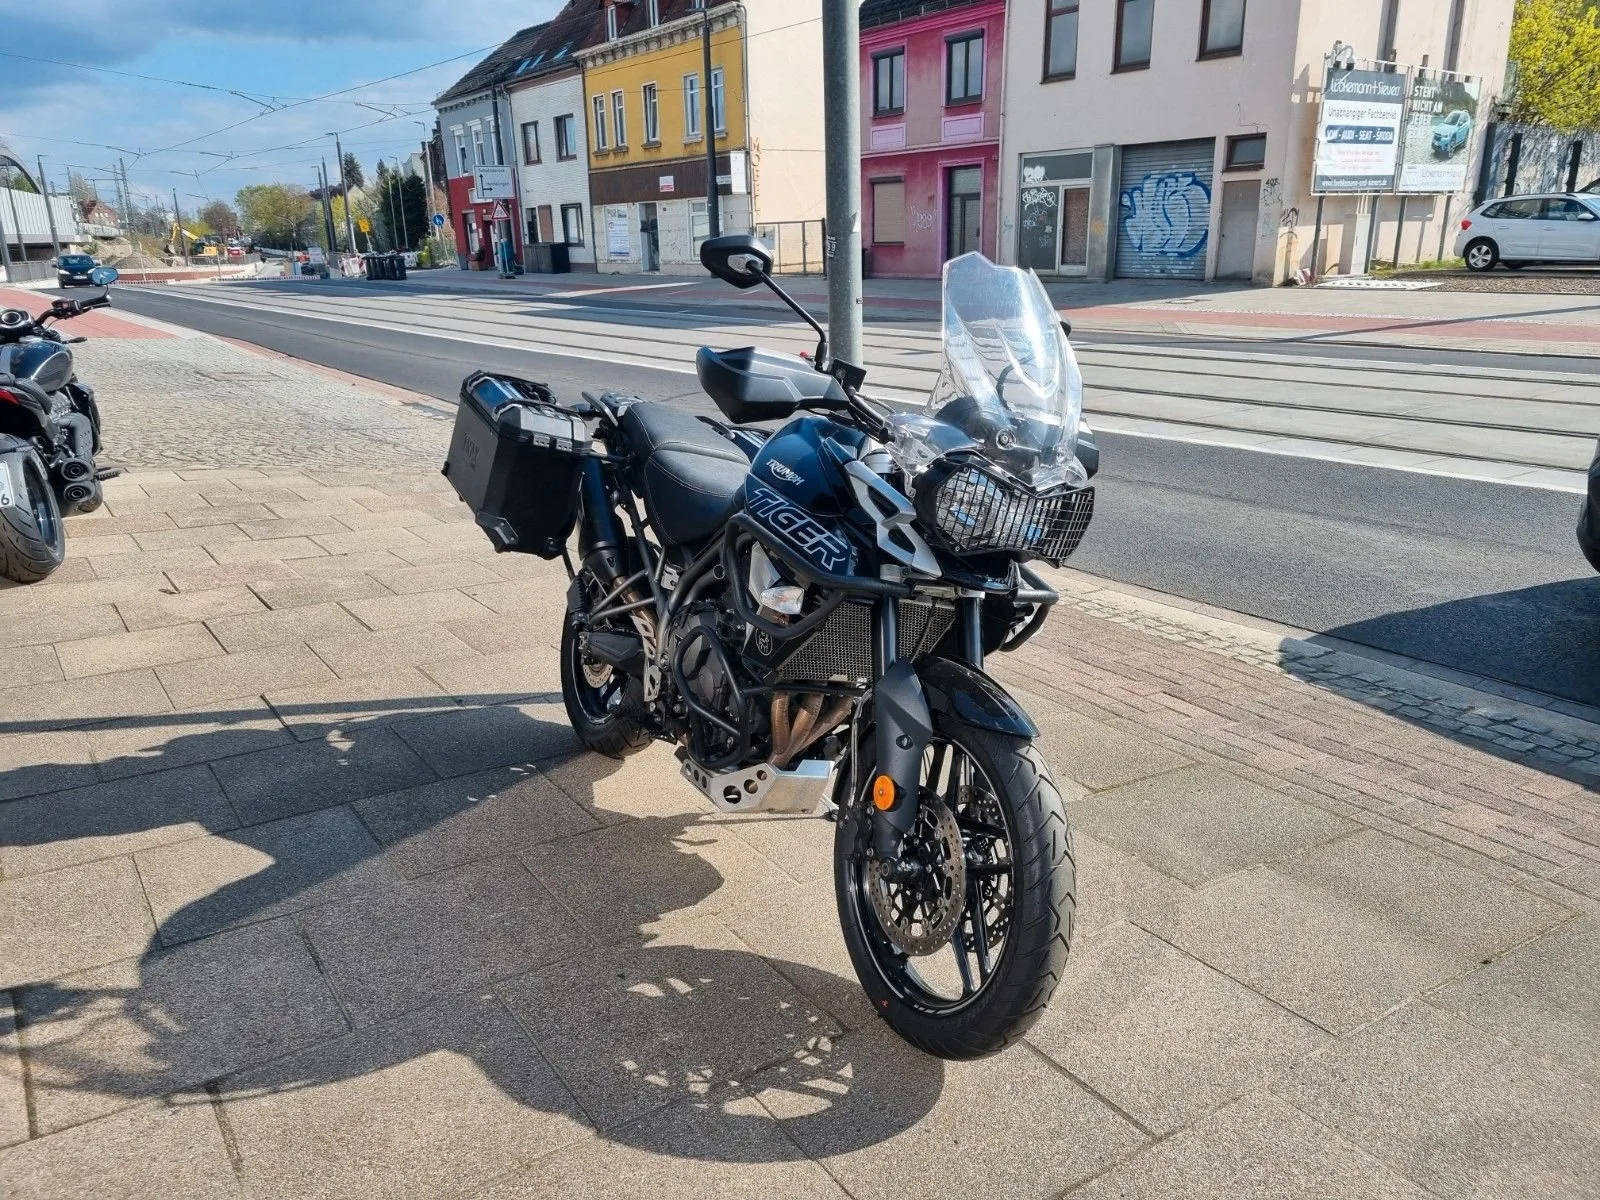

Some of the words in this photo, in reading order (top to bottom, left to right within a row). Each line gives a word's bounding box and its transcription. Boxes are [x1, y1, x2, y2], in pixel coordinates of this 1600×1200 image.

[1414, 85, 1436, 98] STEHT
[1412, 100, 1433, 112] NICHT
[1433, 101, 1443, 113] AN
[1341, 130, 1355, 140] AUDI
[1359, 130, 1373, 140] SEAT
[766, 459, 805, 486] TRIUMPH
[1, 494, 10, 505] 6
[748, 487, 848, 571] TIGER
